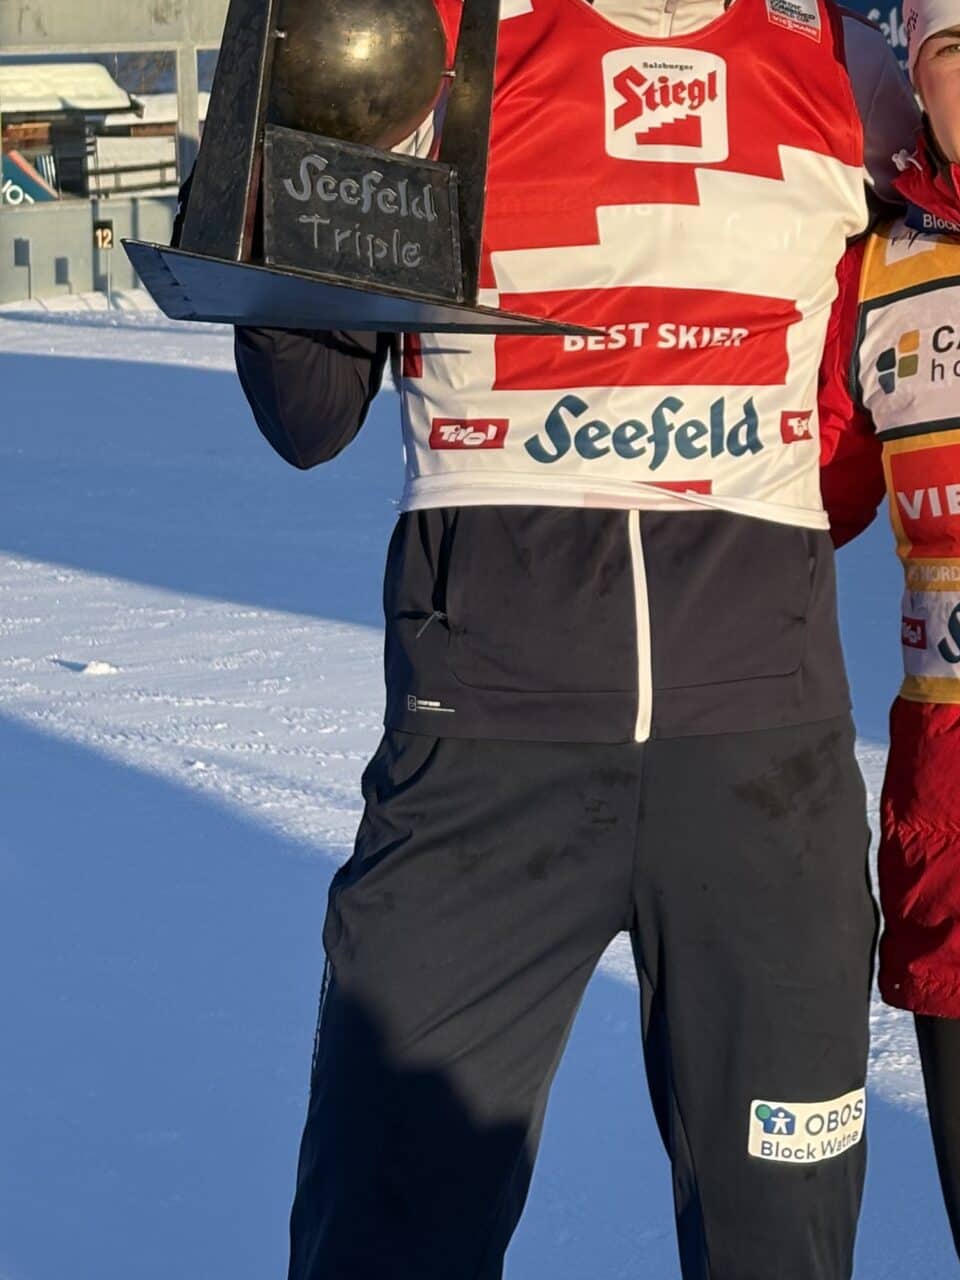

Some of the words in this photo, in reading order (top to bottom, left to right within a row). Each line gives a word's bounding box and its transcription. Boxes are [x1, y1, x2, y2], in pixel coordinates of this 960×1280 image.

[613, 65, 718, 132] Stiegl
[283, 153, 438, 221] Seefeld
[95, 228, 112, 248] 12
[298, 213, 422, 268] Triple
[563, 323, 650, 352] BEST
[657, 322, 749, 351] SKIER
[439, 423, 498, 446] Tirol
[523, 394, 765, 471] Seefeld
[805, 1098, 864, 1136] OBOS
[761, 1140, 817, 1160] Block
[820, 1129, 859, 1157] Watne
